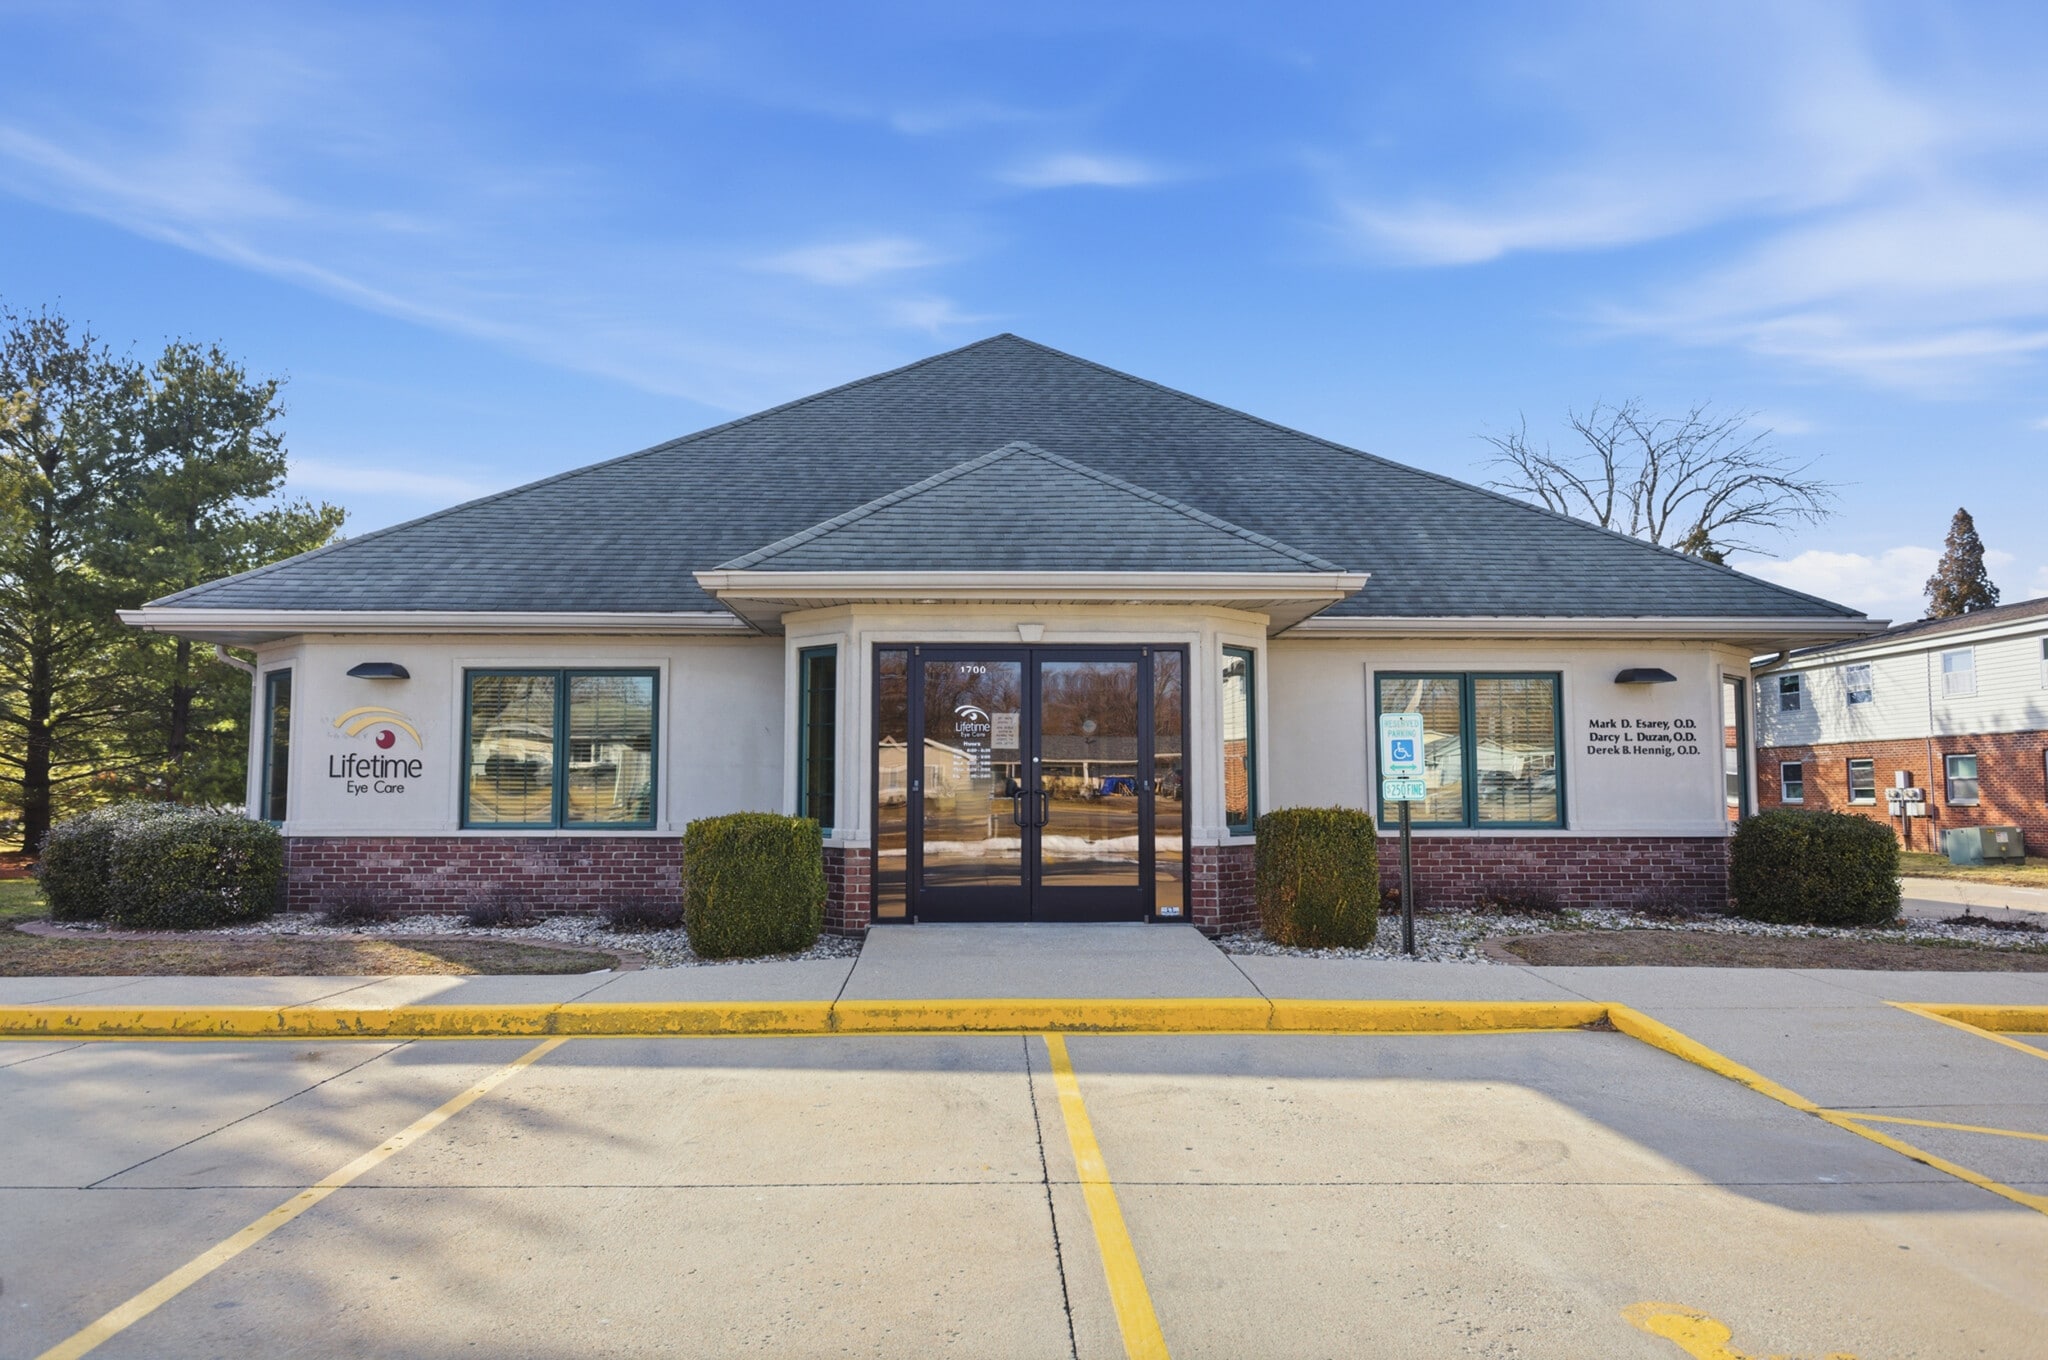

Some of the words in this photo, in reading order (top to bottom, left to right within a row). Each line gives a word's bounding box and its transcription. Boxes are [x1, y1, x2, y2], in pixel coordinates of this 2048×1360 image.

[960, 665, 987, 674] 1700
[955, 722, 991, 732] Lifetime
[1384, 719, 1420, 728] RESERVED
[1589, 719, 1617, 729] Mark
[1621, 719, 1632, 729] D.
[1636, 719, 1670, 731] Esarey,
[1673, 718, 1697, 729] O.D.
[1387, 729, 1417, 738] PARKING
[1589, 732, 1620, 744] Darcy
[1624, 732, 1633, 742] L.
[1637, 732, 1672, 743] Duzan,
[1673, 732, 1697, 742] O.D.
[1587, 745, 1620, 755] Derek
[1622, 745, 1631, 755] B.
[1633, 745, 1675, 757] Hennig,
[1677, 745, 1701, 755] O.D.
[329, 752, 423, 779] Lifetime
[346, 780, 369, 796] Eye
[373, 780, 405, 794] Care
[1386, 783, 1406, 797] $250
[1407, 783, 1423, 796] FINE
